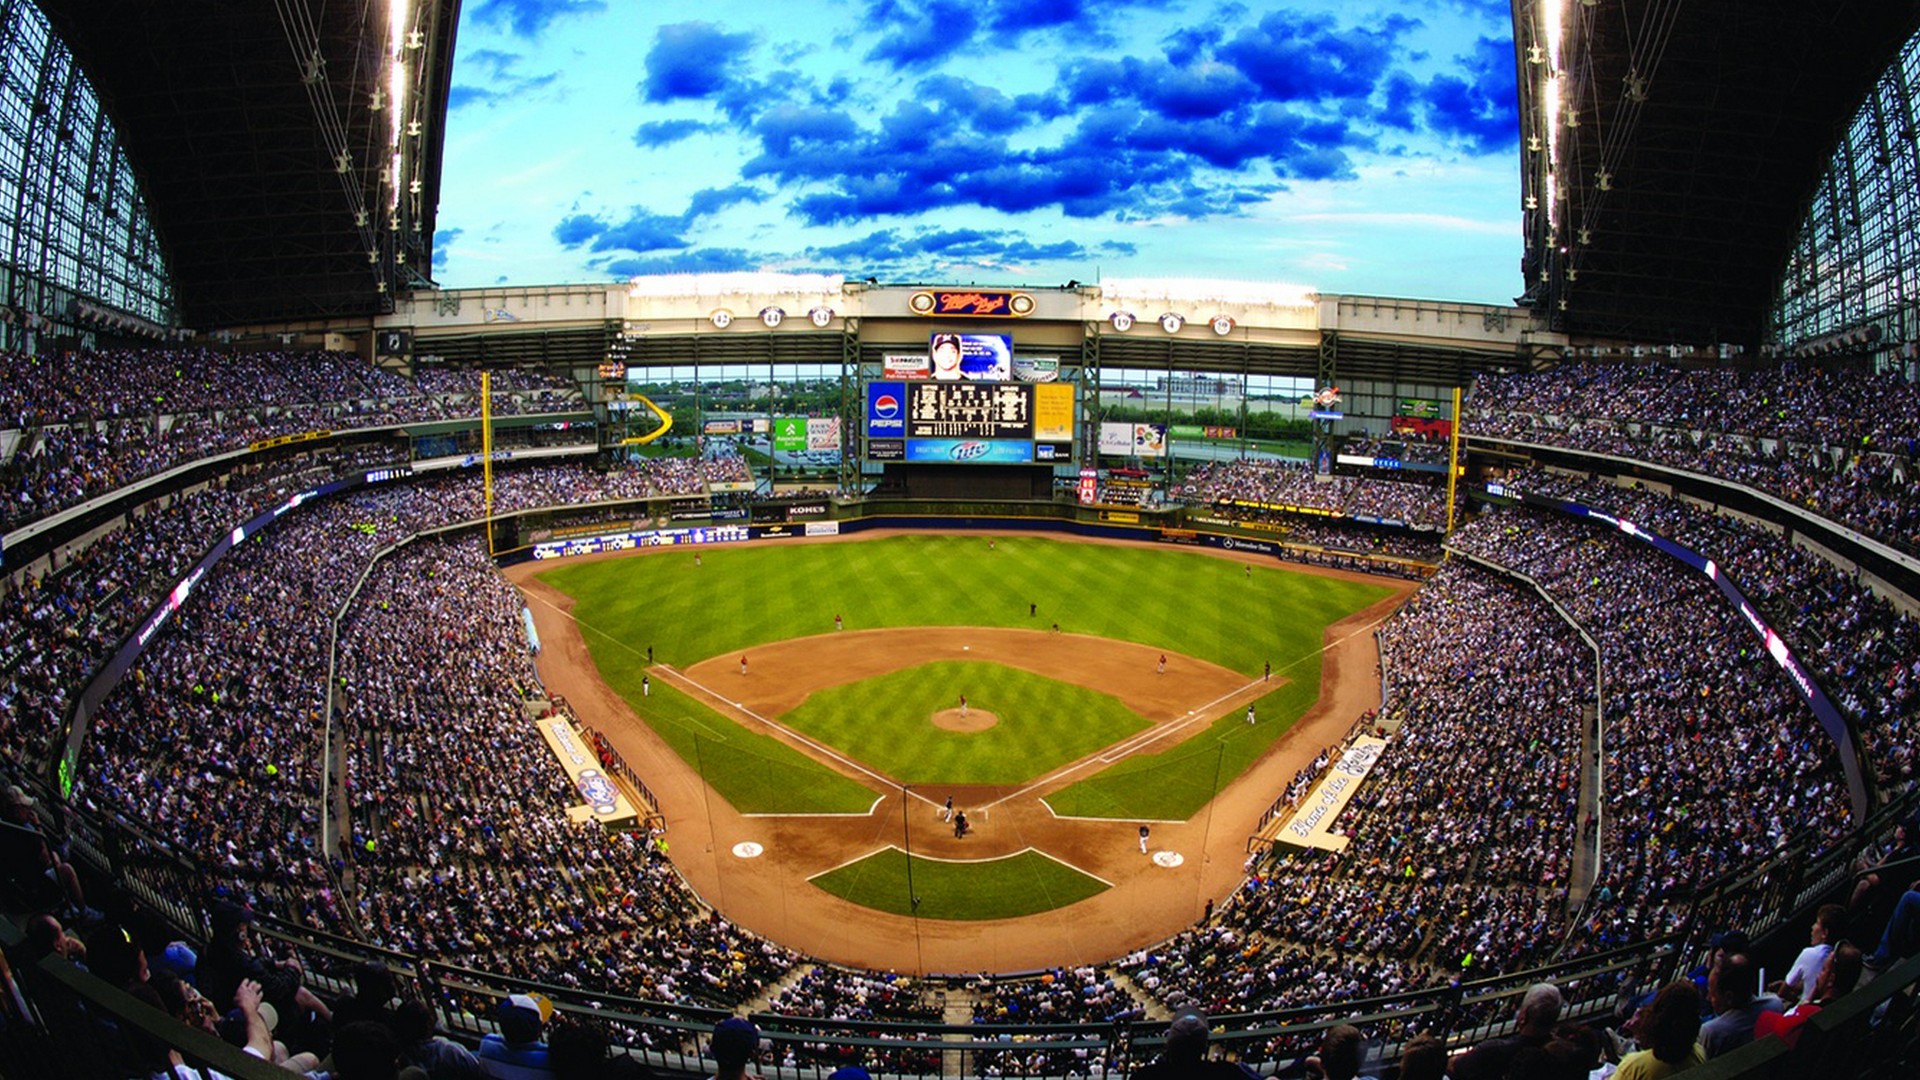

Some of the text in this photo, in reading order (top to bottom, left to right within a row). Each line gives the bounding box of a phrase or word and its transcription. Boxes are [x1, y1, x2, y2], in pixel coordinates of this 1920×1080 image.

[717, 314, 729, 323] 42
[767, 313, 779, 323] 44
[1117, 318, 1129, 327] 19
[870, 419, 903, 428] PEPSI
[1290, 777, 1350, 837] Home of the
